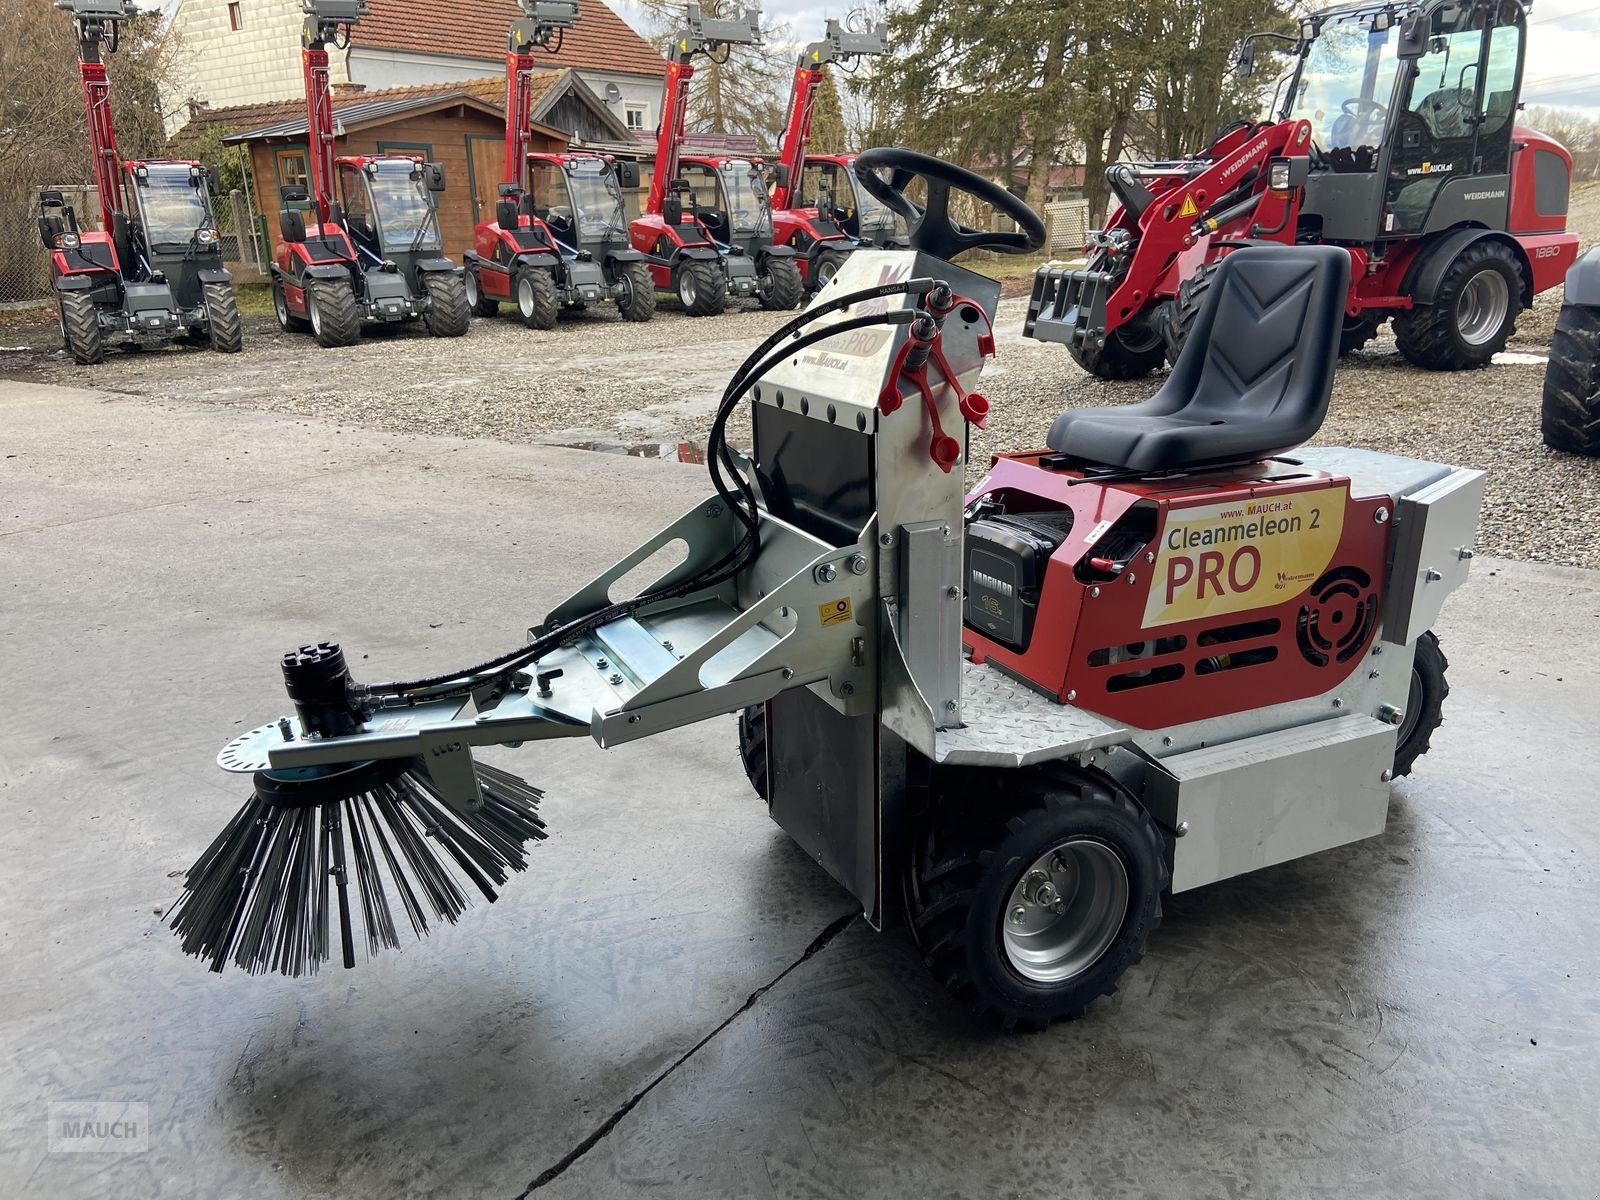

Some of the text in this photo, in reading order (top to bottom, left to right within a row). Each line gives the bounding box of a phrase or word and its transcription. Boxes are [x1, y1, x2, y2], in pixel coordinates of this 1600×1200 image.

[1222, 138, 1268, 178] WEIDEMANN
[1463, 190, 1506, 200] WEIDEMANN
[846, 331, 880, 354] PRO
[1168, 508, 1321, 550] Cleanmeleon 2
[972, 569, 1013, 598] VANGUARD
[1165, 545, 1261, 605] PRO
